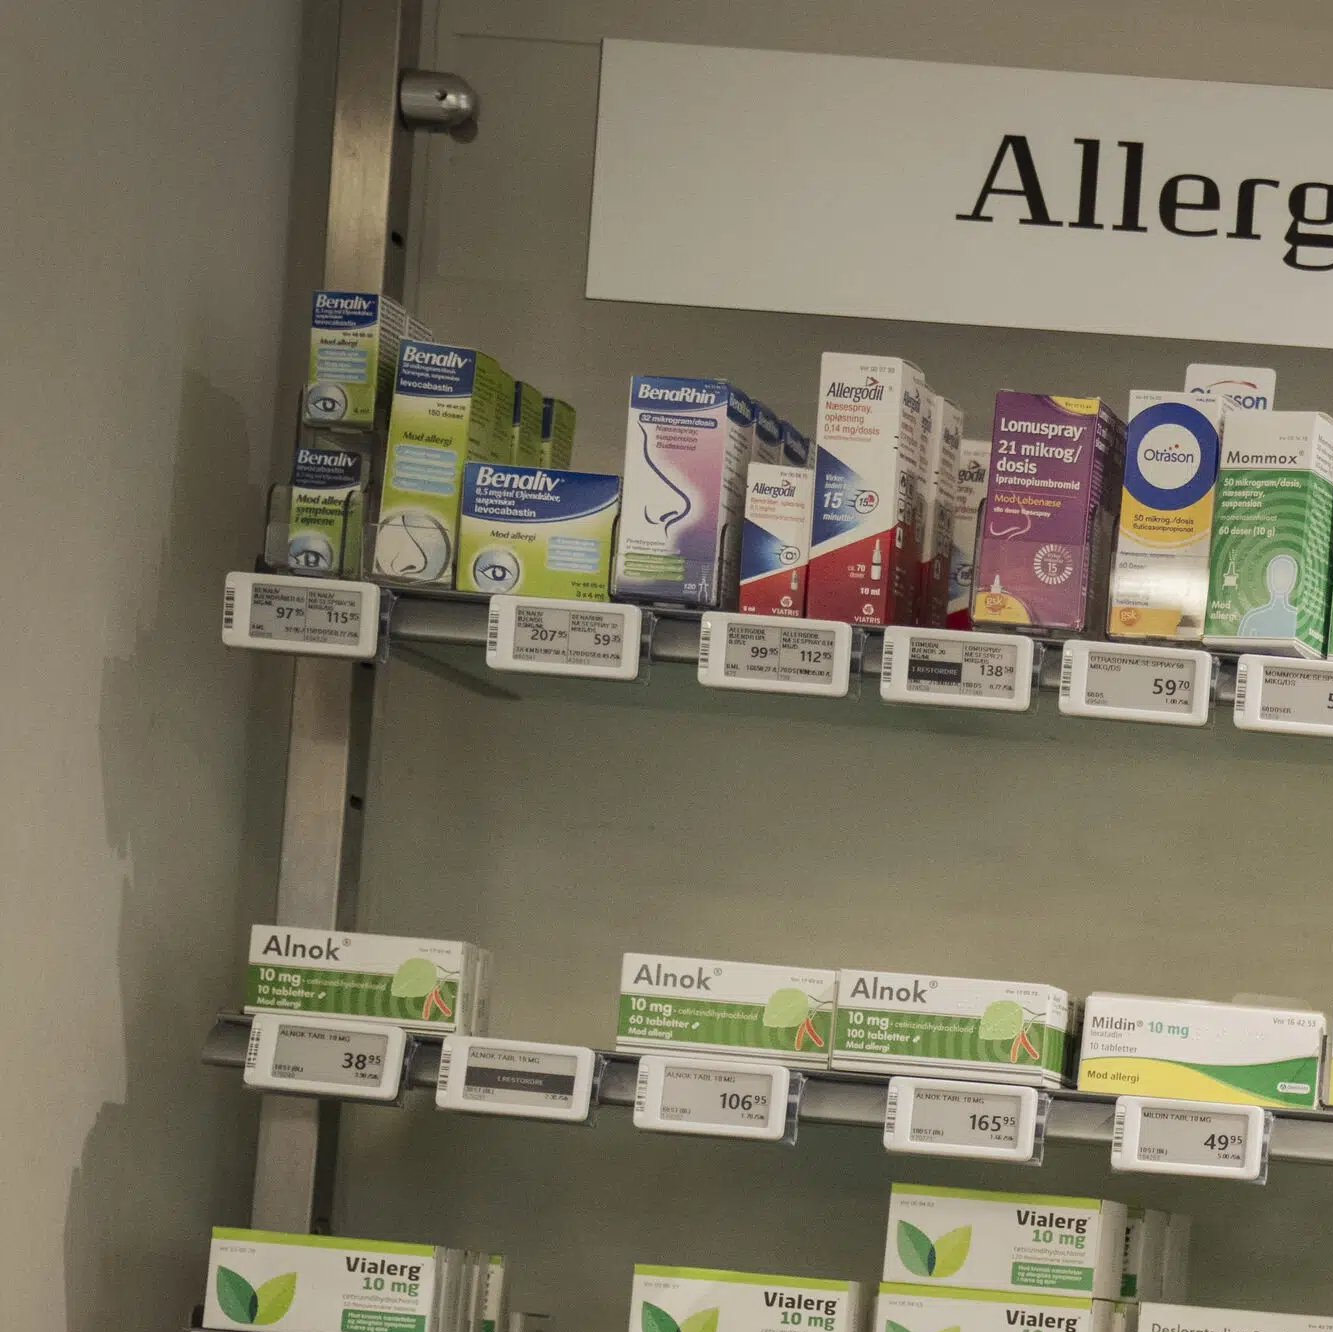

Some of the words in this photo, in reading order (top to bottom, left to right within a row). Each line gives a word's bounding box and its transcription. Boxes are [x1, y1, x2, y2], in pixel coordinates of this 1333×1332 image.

[315, 294, 371, 312] Benaliv
[403, 347, 467, 370] Benaliv
[638, 384, 716, 404] BenaRhin
[827, 381, 884, 404] Allergodil
[1000, 418, 1083, 440] Lomuspray
[999, 440, 1020, 456] 21
[1025, 443, 1081, 463] mikrog/
[997, 459, 1037, 474] dosis
[476, 467, 559, 491] Benaliv
[995, 476, 1080, 491] ipratropiumbromid
[753, 482, 795, 497] Allergodil
[854, 616, 881, 624] VIATRIS
[847, 1029, 865, 1040] 100
[868, 1030, 910, 1044] tabletter
[1148, 1021, 1164, 1035] 10
[1167, 1022, 1189, 1039] mg
[1087, 1070, 1107, 1082] Mod
[1111, 1071, 1139, 1083] allergi
[1016, 1210, 1087, 1235] Vialerg
[1032, 1229, 1052, 1245] 10
[1057, 1231, 1086, 1249] mg
[345, 1257, 420, 1282] Vialerg
